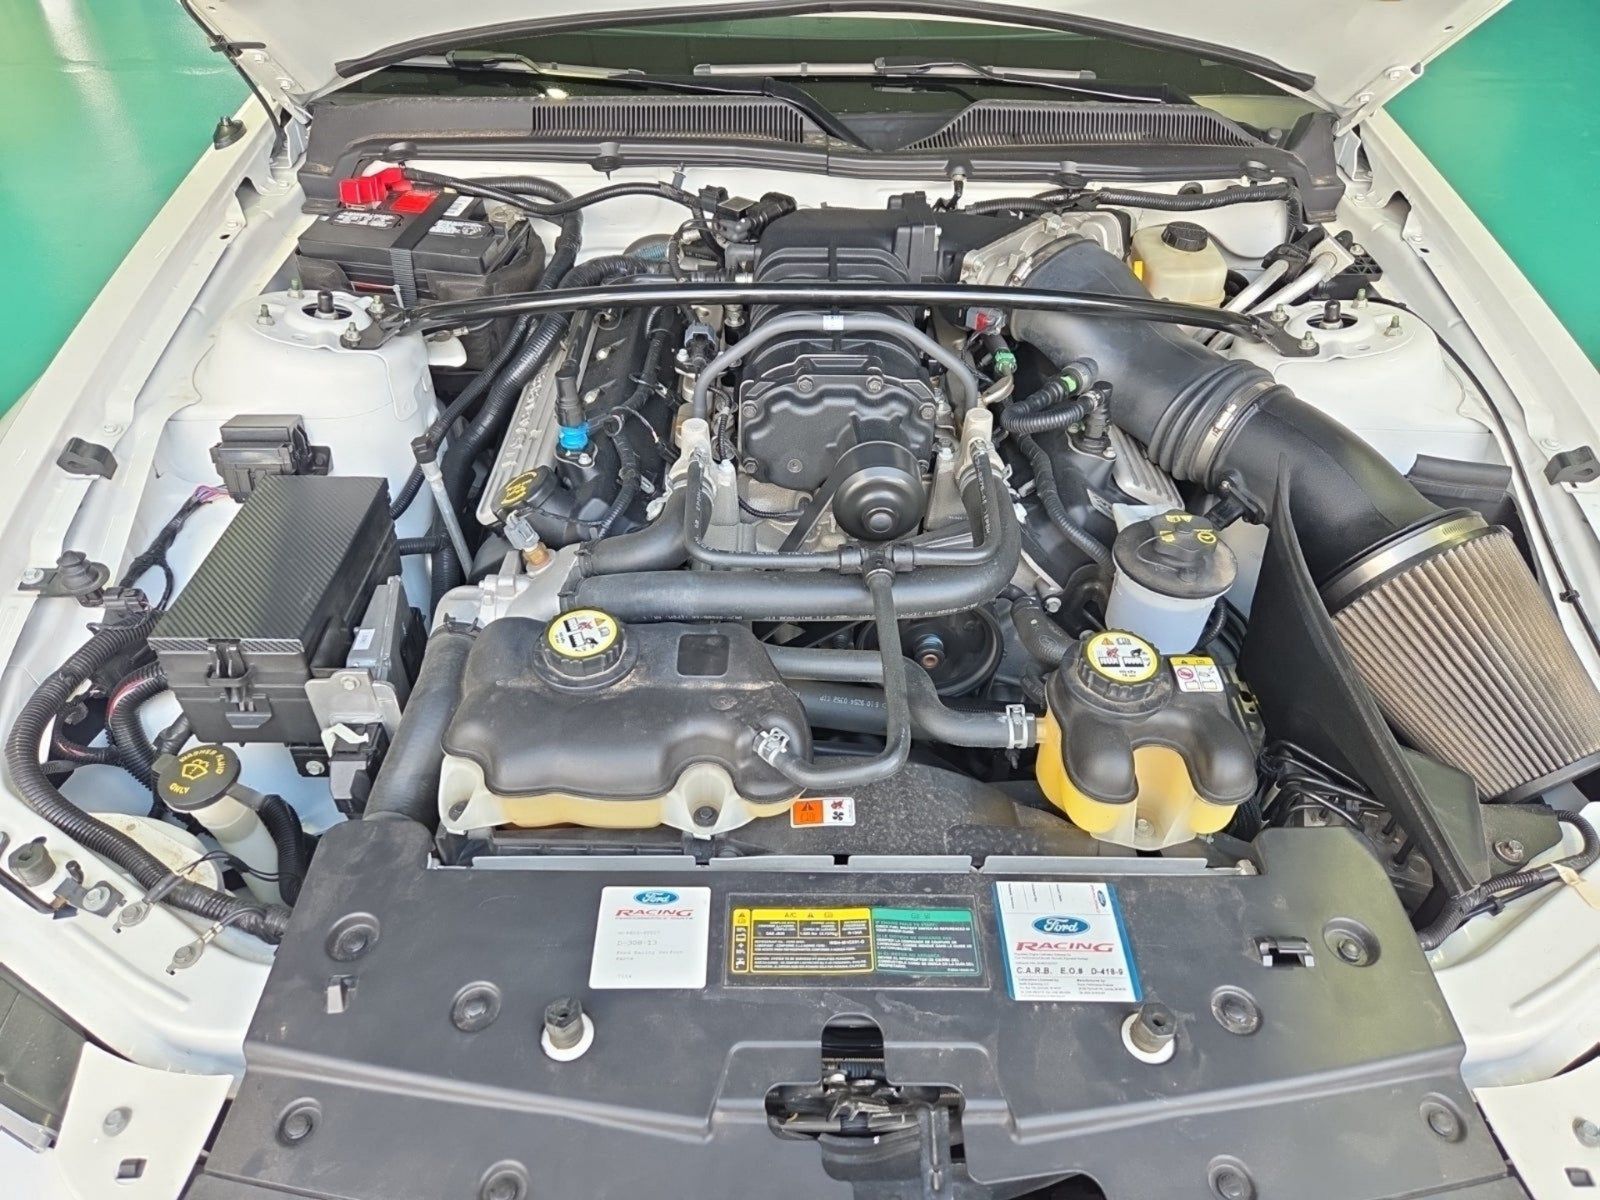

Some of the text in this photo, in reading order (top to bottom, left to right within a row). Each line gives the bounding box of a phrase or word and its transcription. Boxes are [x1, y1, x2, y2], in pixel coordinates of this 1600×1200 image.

[179, 749, 226, 774] WASHER FLUID
[170, 782, 190, 794] ONLY
[642, 892, 671, 902] Ford
[615, 909, 694, 917] RACING
[1044, 918, 1078, 932] Ford
[1016, 942, 1114, 952] RACING
[1016, 967, 1124, 976] C.A.R.B. E.O.# D-418-9
